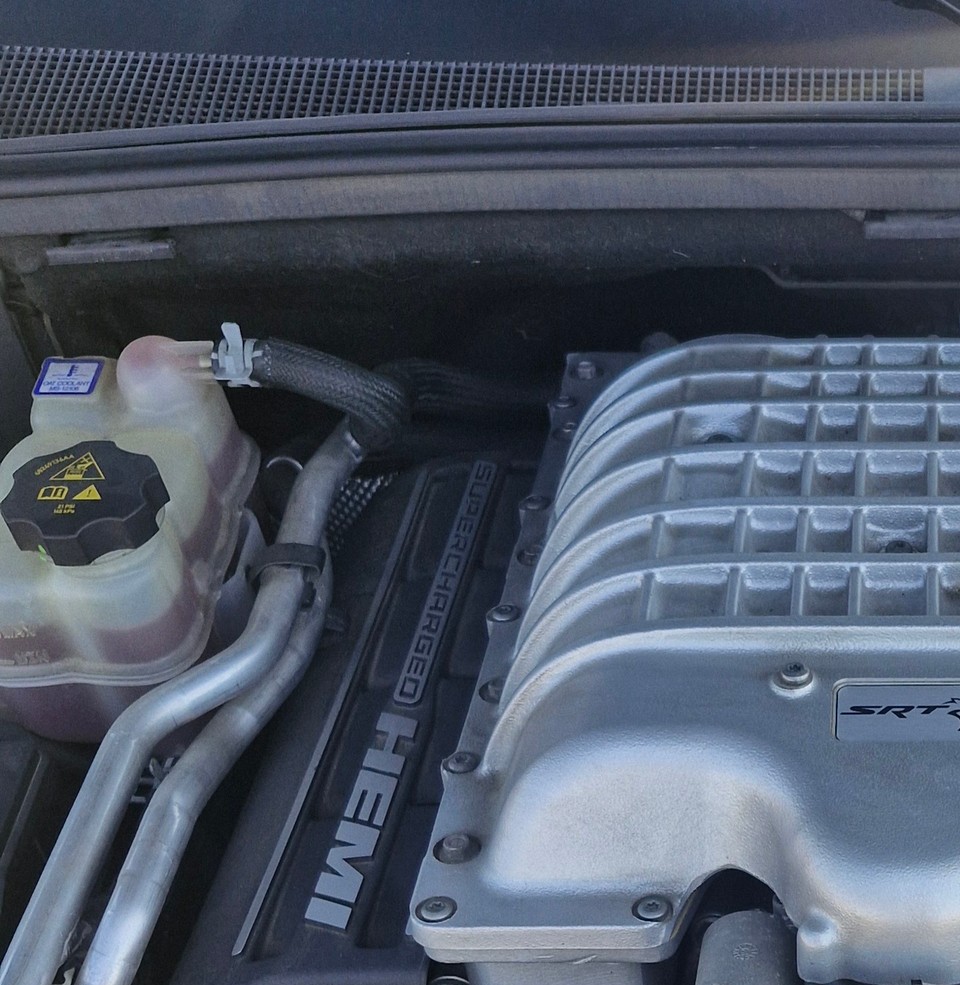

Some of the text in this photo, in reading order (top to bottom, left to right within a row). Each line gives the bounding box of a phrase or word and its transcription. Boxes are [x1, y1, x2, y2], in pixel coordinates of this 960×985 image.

[399, 463, 494, 700] SUPERCHARGED
[840, 705, 950, 718] SRT
[305, 712, 418, 931] HEMI
